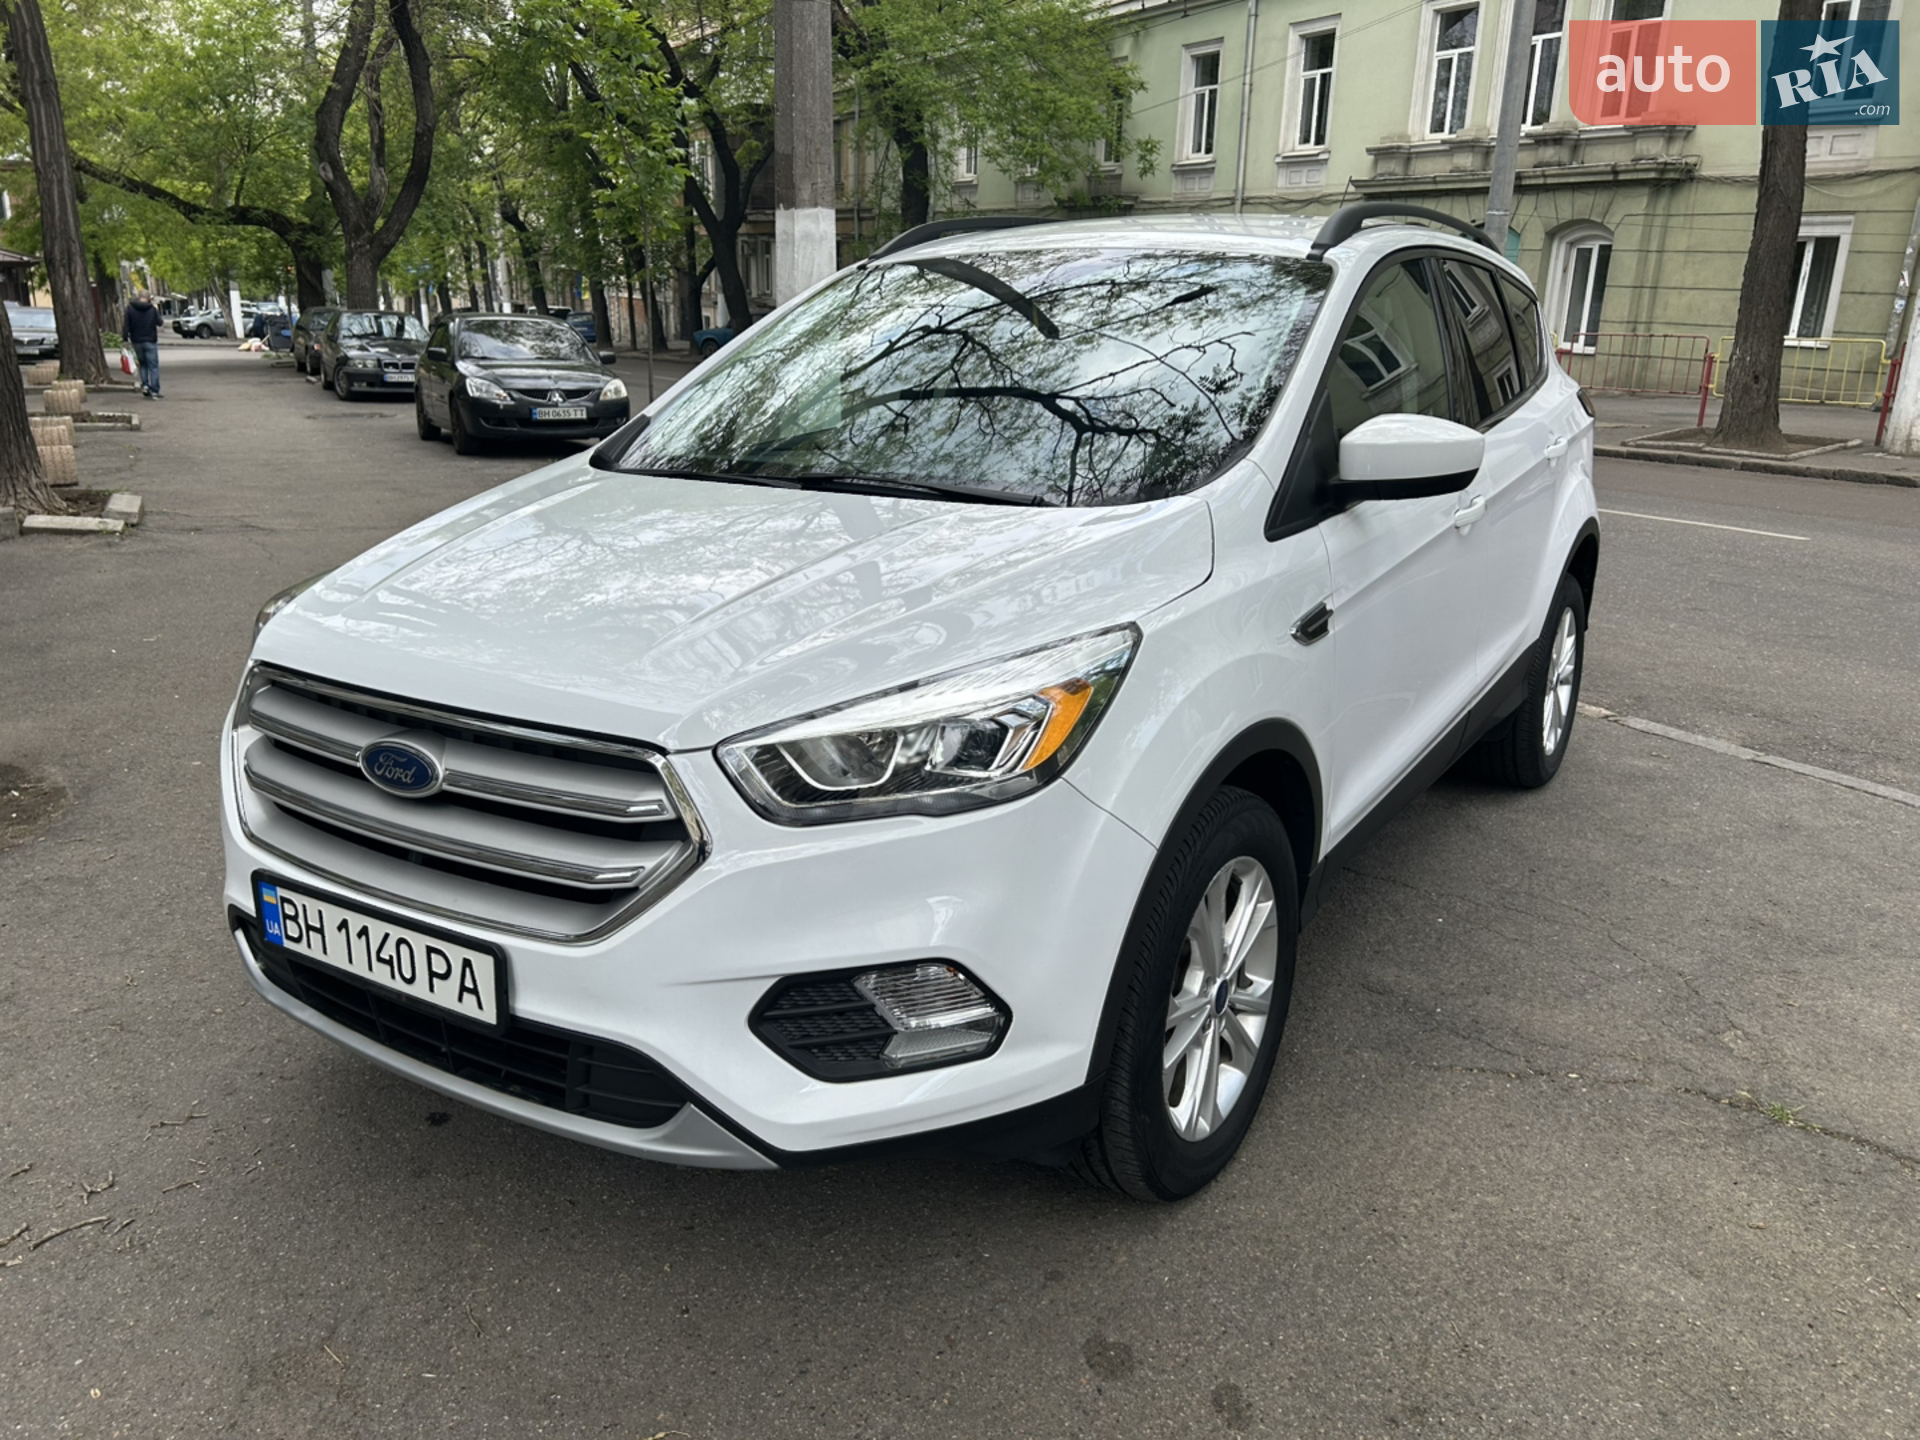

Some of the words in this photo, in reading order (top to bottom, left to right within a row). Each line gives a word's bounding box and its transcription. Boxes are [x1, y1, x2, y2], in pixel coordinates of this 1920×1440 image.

[374, 752, 417, 784] Ford
[265, 919, 281, 936] UA
[280, 895, 328, 956] BH
[336, 918, 416, 985] 1140
[425, 944, 484, 1011] PA
